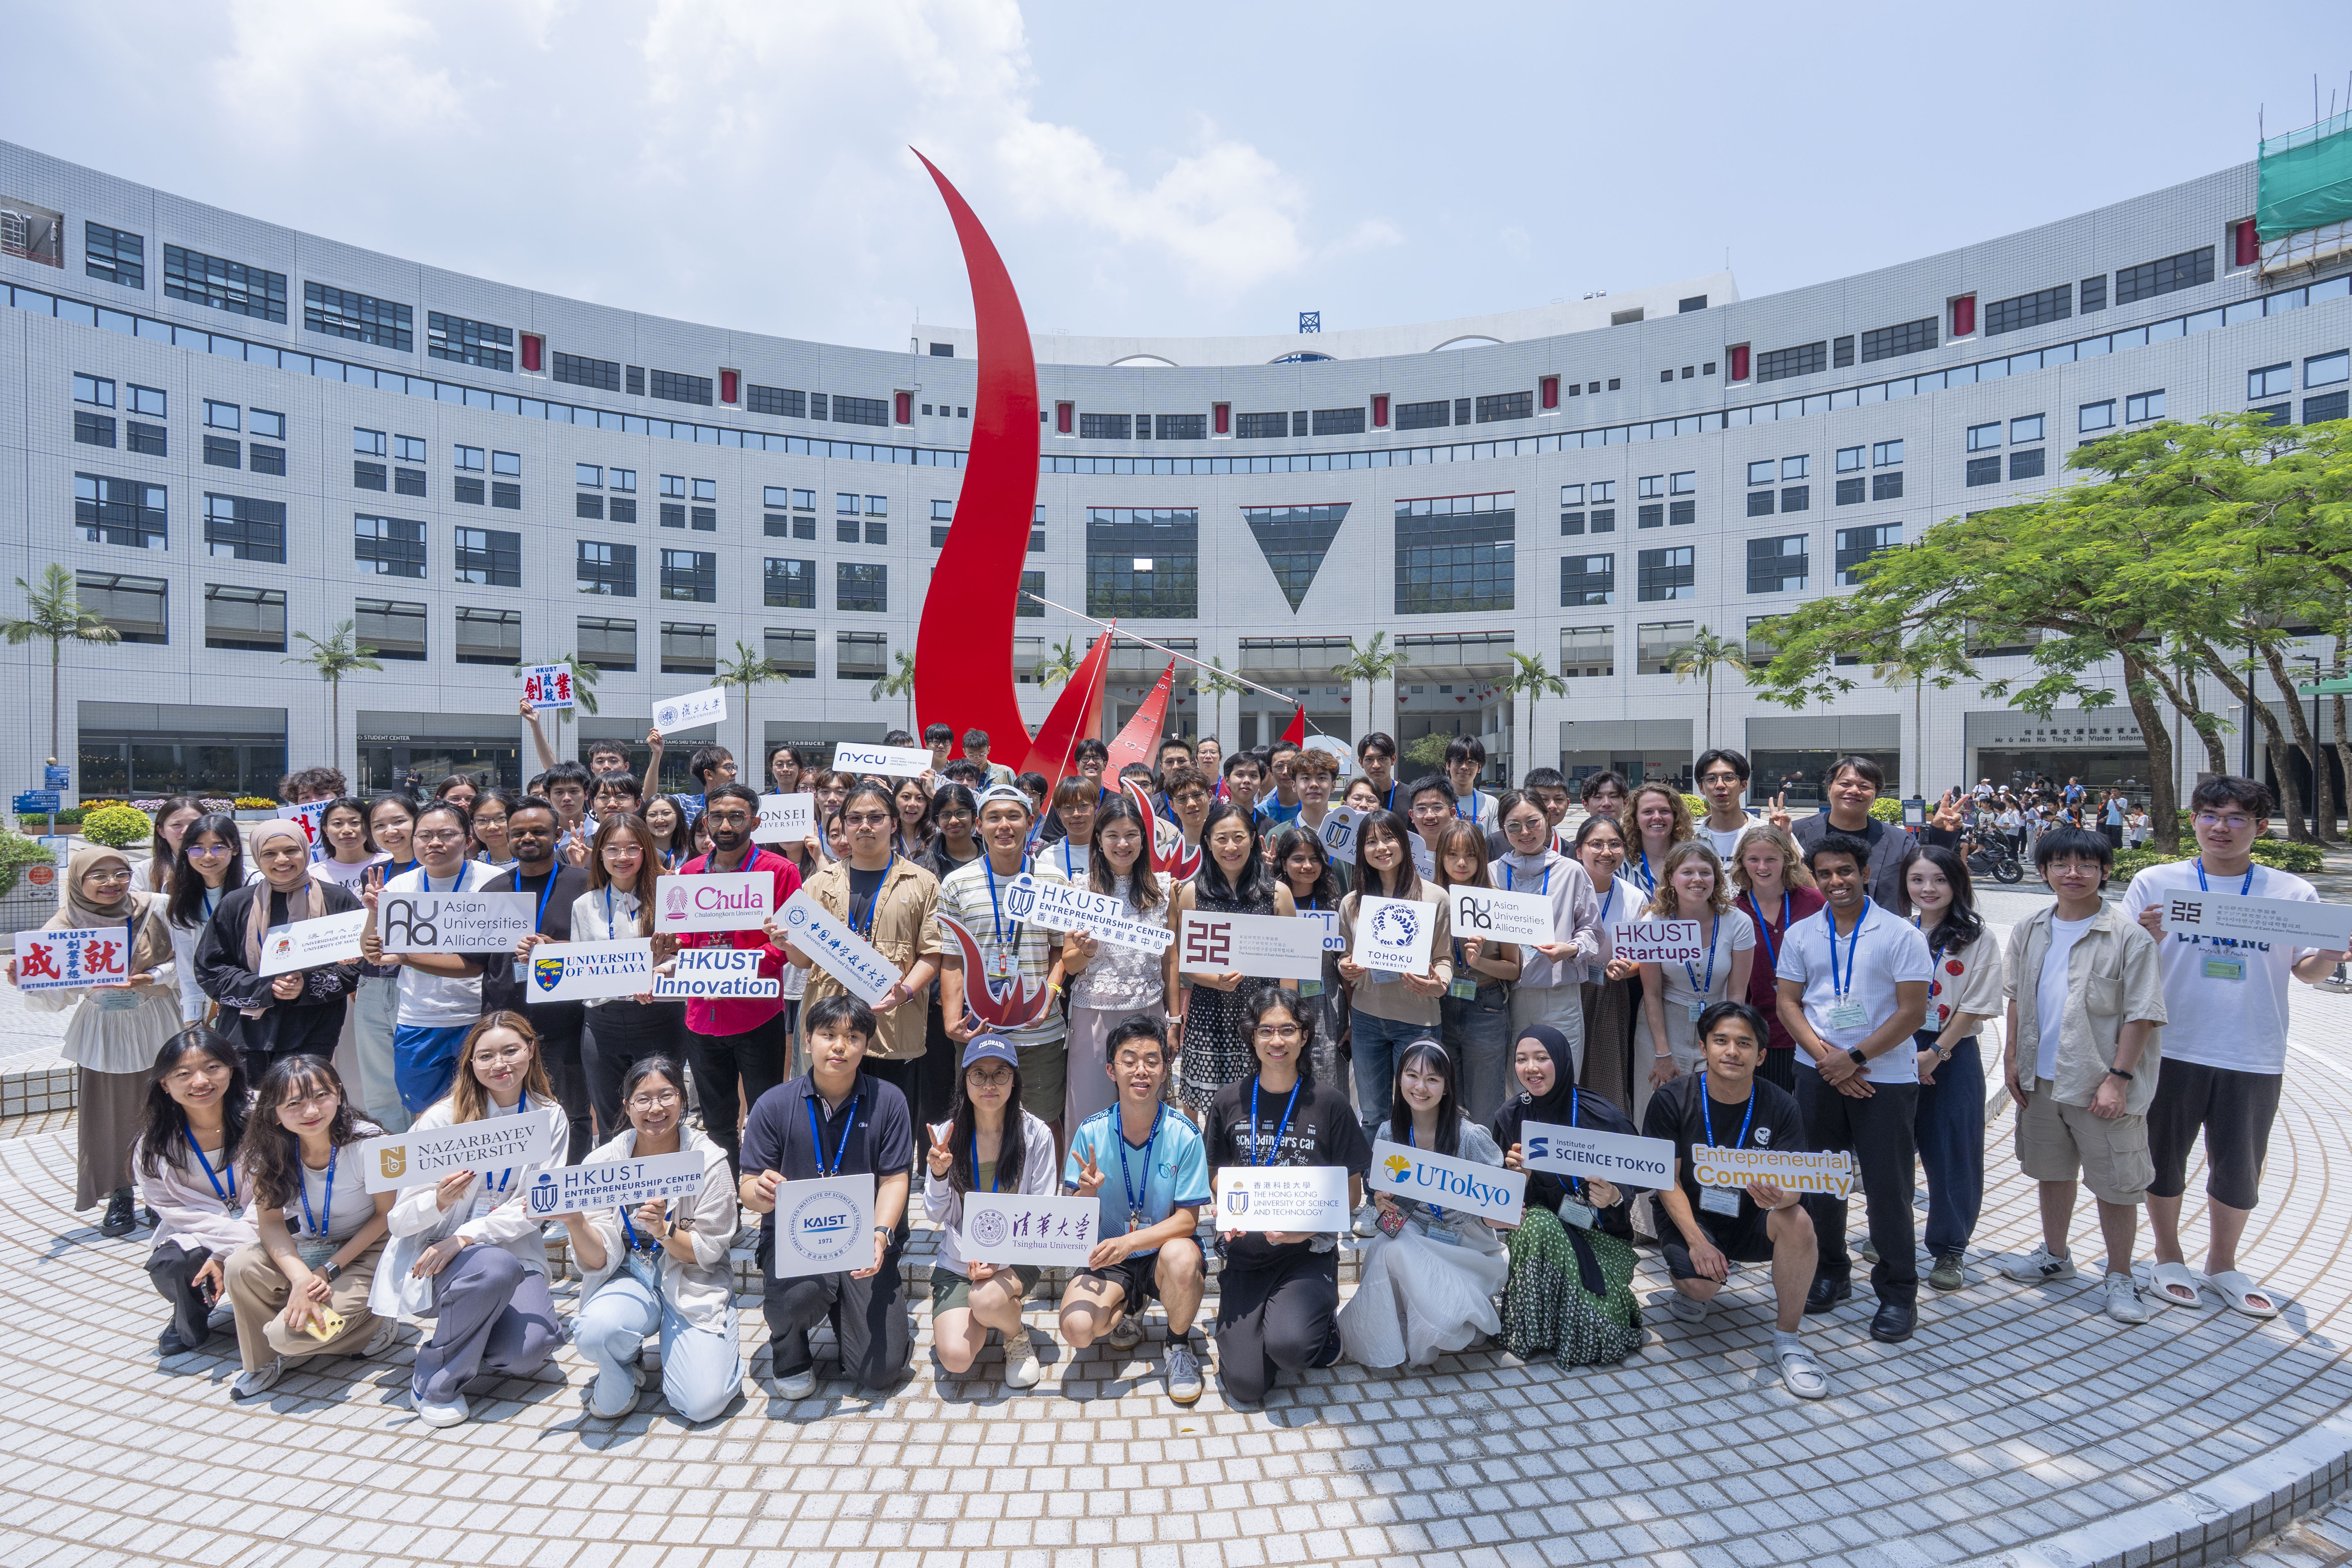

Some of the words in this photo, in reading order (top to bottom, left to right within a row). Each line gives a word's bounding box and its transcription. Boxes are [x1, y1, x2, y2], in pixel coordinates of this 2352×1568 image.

[525, 676, 542, 701] 創
[555, 673, 571, 699] 業
[697, 709, 721, 718] UNIVERSITY
[1125, 741, 1137, 750] 3
[839, 752, 886, 765] NYCU
[301, 802, 328, 812] HKUS
[759, 809, 805, 821] ONSEI
[695, 884, 763, 910] Chula
[1042, 885, 1120, 916] HKUST
[444, 901, 486, 912] Asian
[1494, 901, 1519, 910] Asian
[444, 917, 528, 929] Universities
[1040, 903, 1133, 930] ENTREPRENEURSHIP
[1136, 926, 1170, 940] CENTER
[1494, 912, 1544, 925] Universities
[48, 930, 97, 939] HKUST
[1037, 912, 1162, 950] 香港科技大學創業中心
[1495, 923, 1533, 935] Alliance
[1616, 923, 1696, 943] HKUST
[302, 936, 338, 947] UNIVERSIDADE
[304, 943, 334, 952] UNIVERSITY
[443, 935, 507, 946] Alliance
[21, 942, 60, 980] 成
[84, 940, 124, 974] 就
[66, 940, 81, 979] 創業夢想
[567, 952, 647, 966] UNIVERSITY
[679, 951, 762, 969] HKUST
[1368, 951, 1412, 963] TOHOKU
[1615, 946, 1701, 963] Startups
[804, 931, 822, 948] University
[825, 949, 838, 962] Science
[844, 965, 863, 982] Technology
[867, 983, 878, 993] China
[1371, 960, 1407, 969] UNIVERSITY
[566, 967, 584, 977] OF
[588, 963, 646, 976] MALAYA
[21, 979, 95, 990] ENTREPRENEURSHIP
[655, 976, 777, 994] Innovation
[978, 1040, 1005, 1049] COLORADO
[418, 1125, 535, 1157] NAZARBAYEV
[1300, 1138, 1314, 1150] cat
[1557, 1139, 1586, 1149] Institute
[418, 1141, 528, 1170] UNIVERSITY
[1556, 1148, 1612, 1167] SCIENCE
[1615, 1157, 1666, 1174] TOKYO
[1695, 1147, 1848, 1169] Entrepreneurial
[565, 1164, 645, 1188] HKUST
[1697, 1165, 1850, 1197] Community
[565, 1179, 662, 1198] ENTREPRENEURSHIP
[666, 1173, 701, 1184] CENTER
[1416, 1163, 1510, 1207] UTokyo
[565, 1184, 695, 1209] 香港科技大學創業中心
[798, 1193, 823, 1211] INSTITUTE
[832, 1193, 852, 1205] SCIENCE
[791, 1210, 800, 1236] ADVANCED
[804, 1214, 846, 1228] KAIST
[848, 1214, 860, 1246] TECHNOLOGY
[793, 1237, 803, 1251] KOREA
[1013, 1240, 1047, 1250] Tsinghua
[1050, 1241, 1088, 1251] University
[807, 1248, 843, 1260] 한국과학기술원
